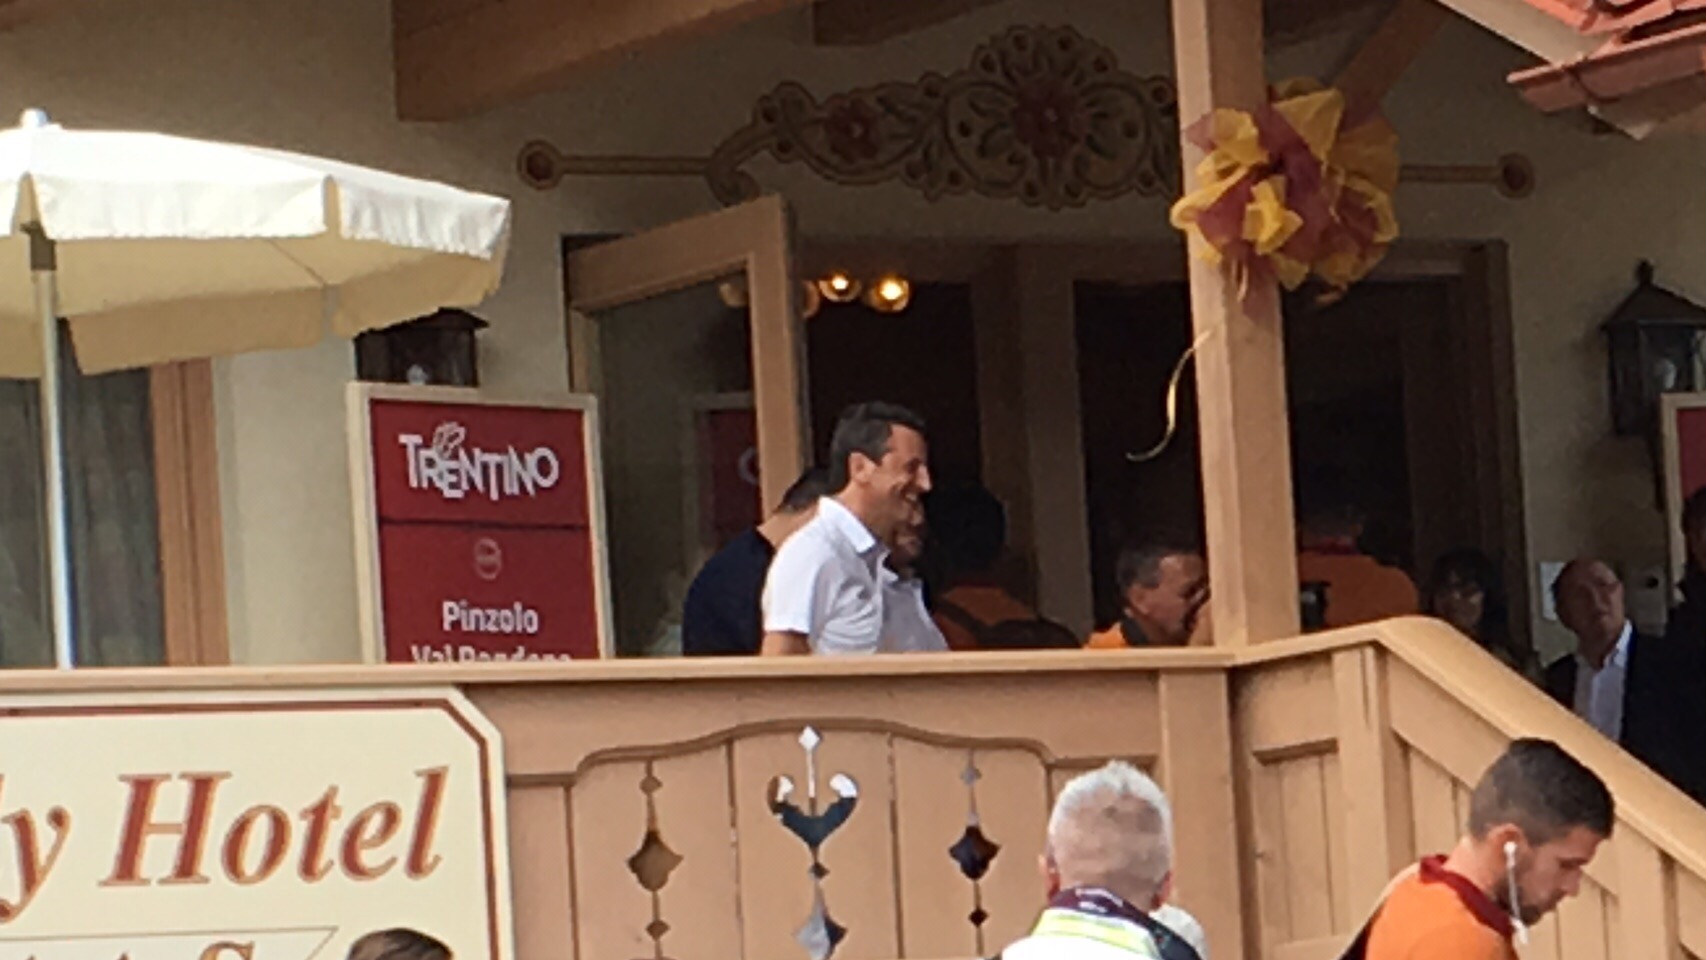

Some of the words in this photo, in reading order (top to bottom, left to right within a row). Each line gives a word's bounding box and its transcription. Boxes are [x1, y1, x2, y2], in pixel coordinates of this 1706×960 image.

[398, 432, 560, 501] TRENTINO
[441, 599, 540, 634] Pinzolo
[0, 772, 72, 923] y
[97, 765, 450, 887] Hotel
